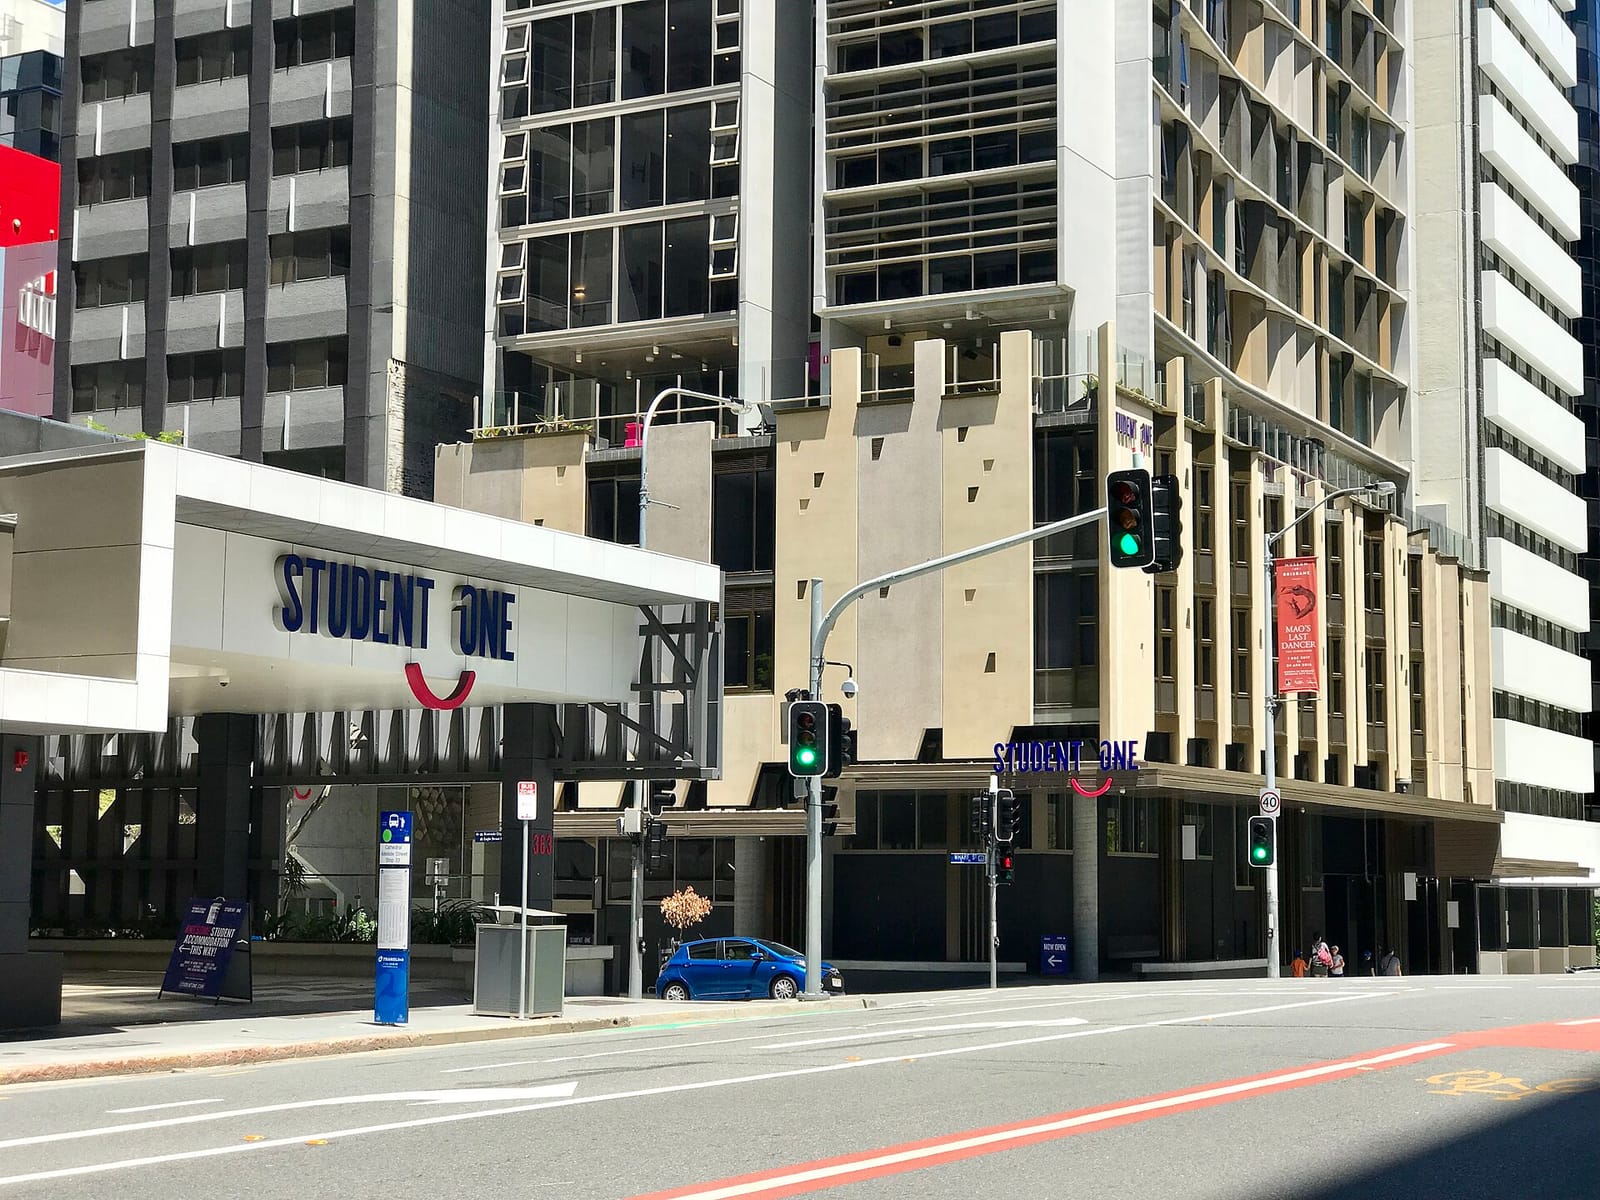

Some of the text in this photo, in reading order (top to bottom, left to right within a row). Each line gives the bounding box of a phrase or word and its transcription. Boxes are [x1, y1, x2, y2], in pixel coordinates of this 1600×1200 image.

[277, 553, 516, 662] STUDENT ONE
[1284, 624, 1312, 633] MAO'S
[1287, 633, 1309, 641] LAST
[1281, 641, 1316, 650] DANCER
[993, 740, 1139, 773] STUDENT ONE
[1262, 796, 1277, 808] 40
[533, 832, 553, 856] 363
[210, 927, 236, 938] STUDENT
[183, 934, 230, 948] ACCOMMODATION
[190, 945, 217, 957] THIS WAY!
